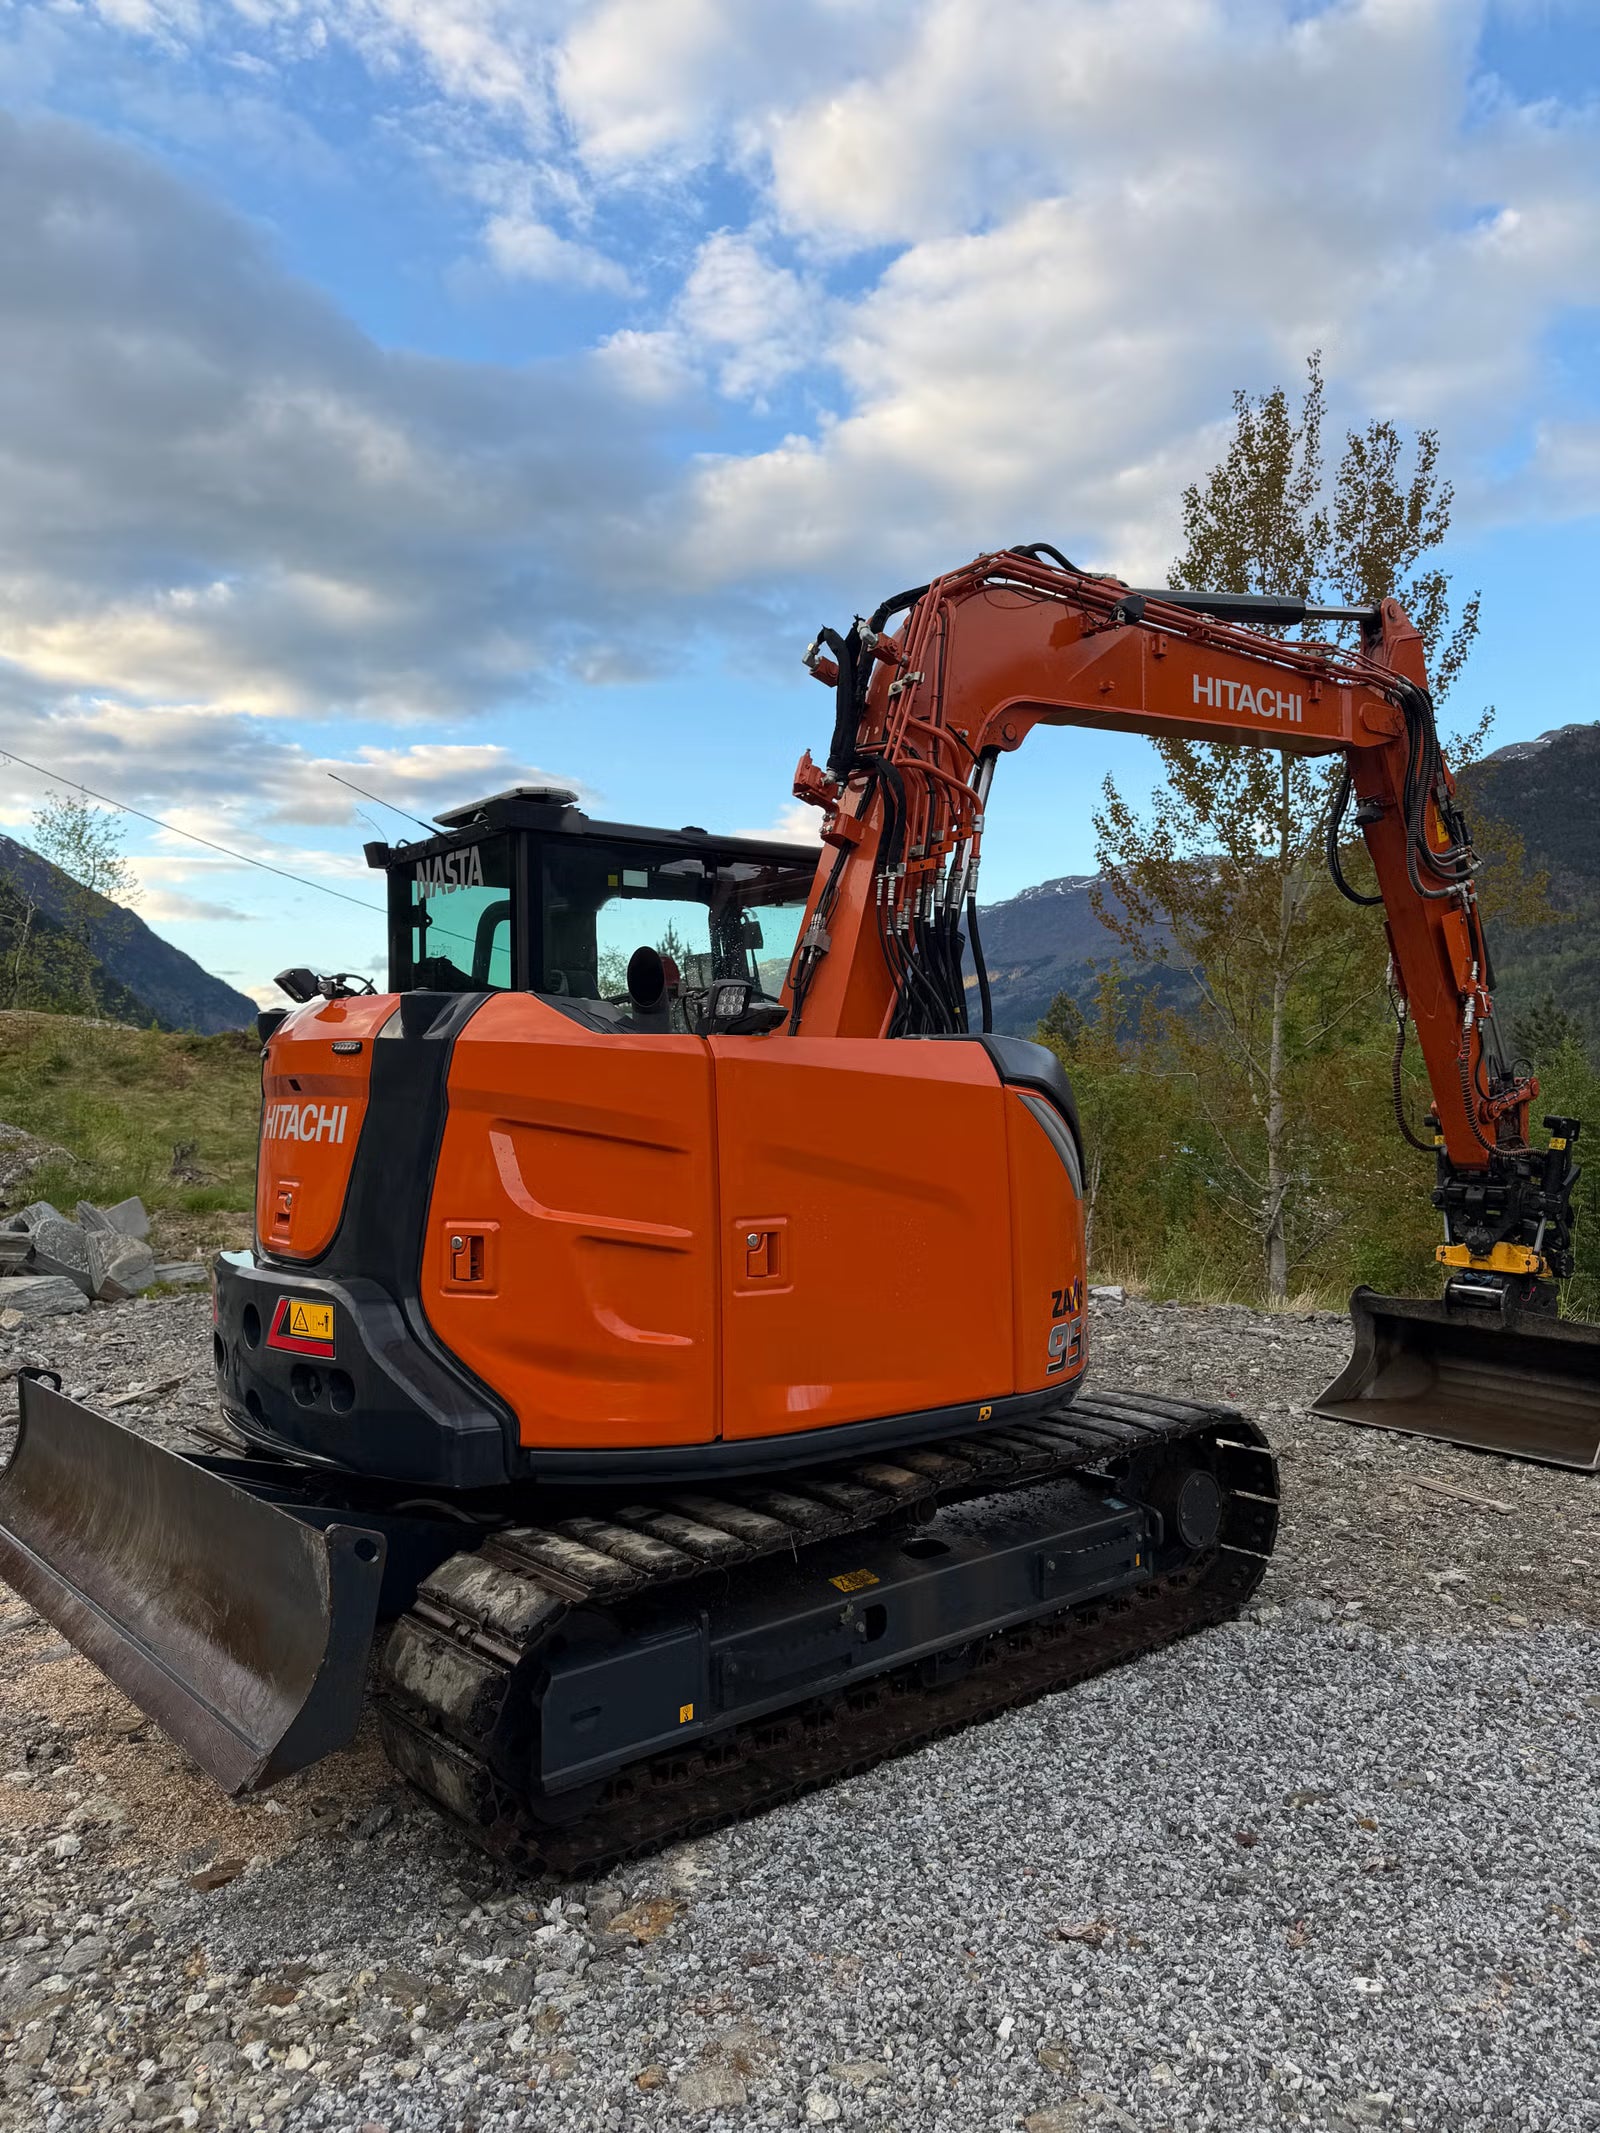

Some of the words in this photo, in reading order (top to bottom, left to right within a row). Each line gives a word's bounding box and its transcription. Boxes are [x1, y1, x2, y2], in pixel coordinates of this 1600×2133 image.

[1193, 673, 1302, 722] HITACHI
[416, 845, 484, 902] NASTA
[263, 1103, 348, 1144] HITACHI
